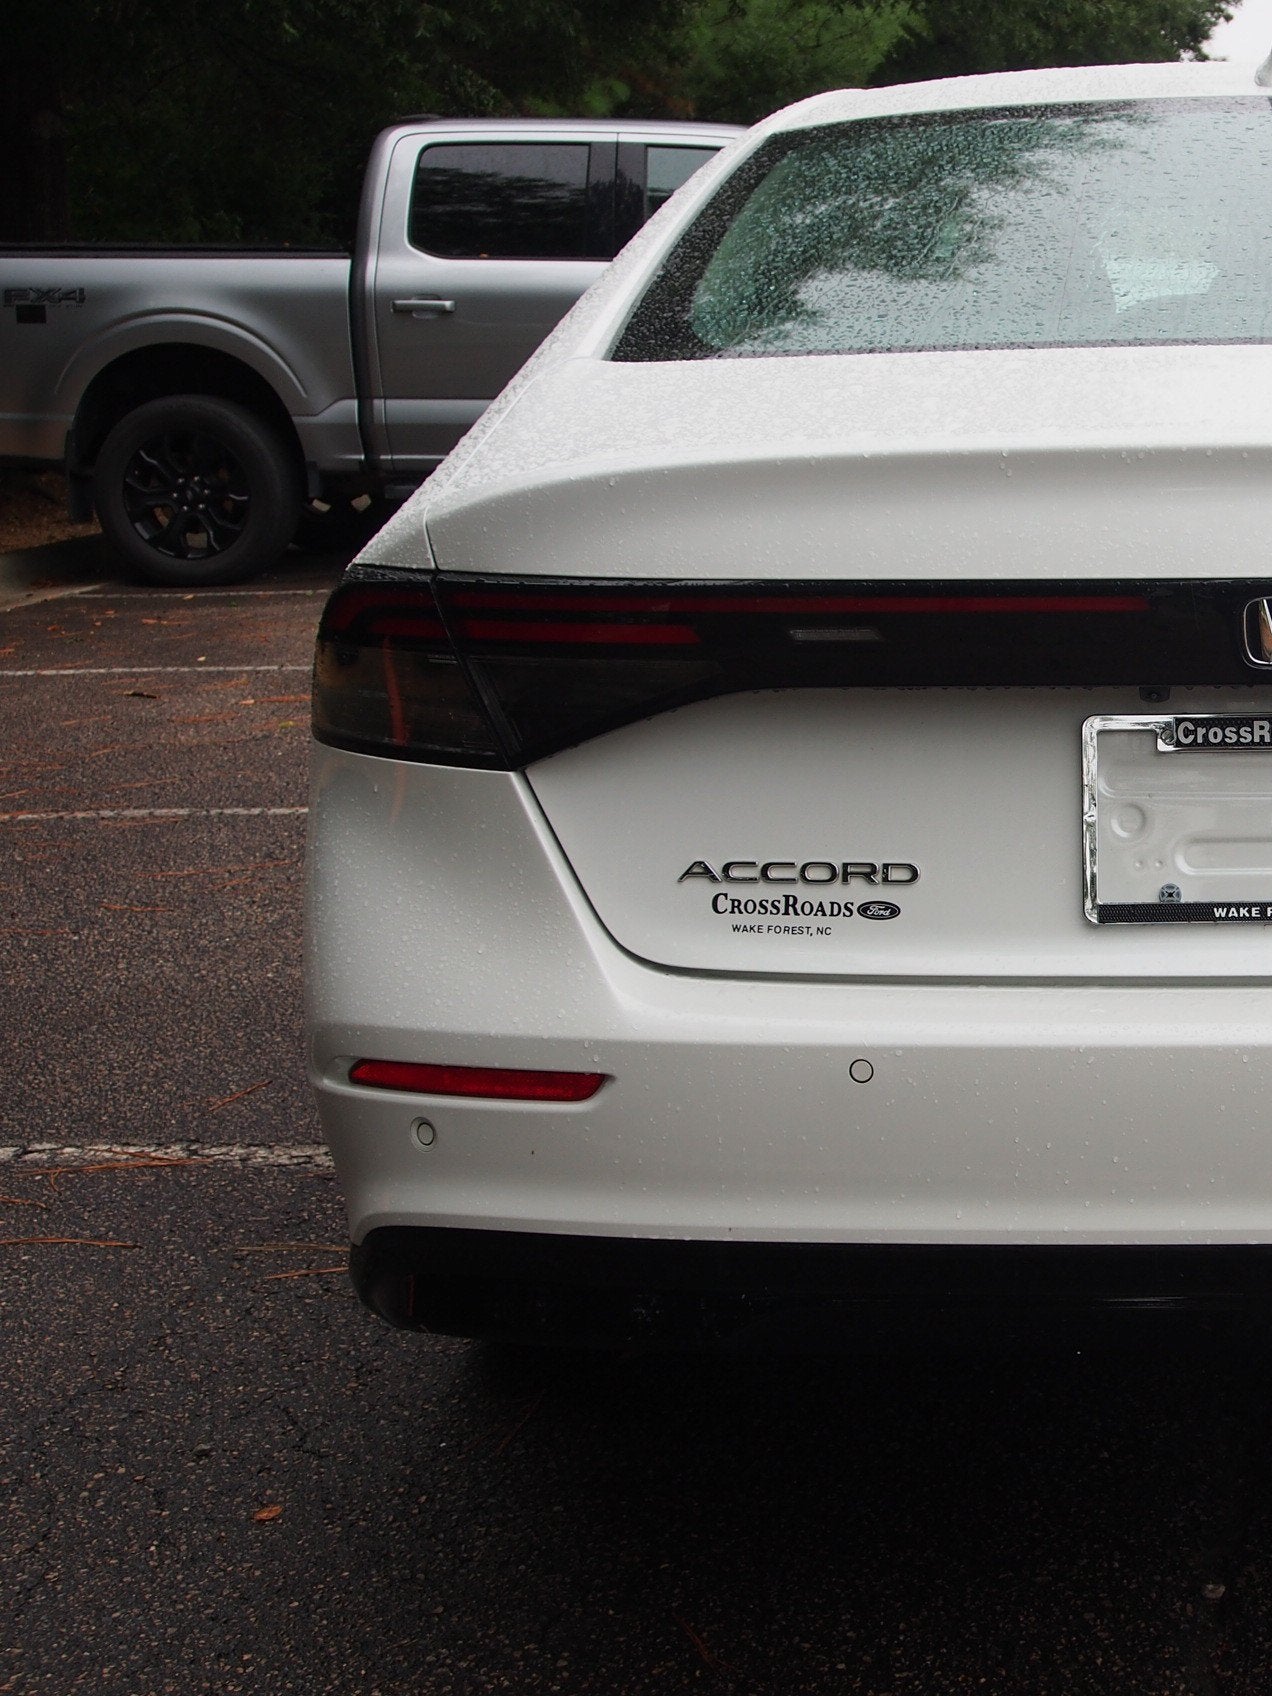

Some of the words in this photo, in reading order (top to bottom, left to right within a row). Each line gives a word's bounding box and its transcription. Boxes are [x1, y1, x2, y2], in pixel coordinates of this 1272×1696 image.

[4, 287, 87, 304] FX4
[677, 860, 921, 886] ACCORD
[1213, 906, 1263, 918] WAKE
[731, 924, 764, 934] WAKE
[767, 925, 814, 937] FOREST,
[816, 926, 832, 936] NC
